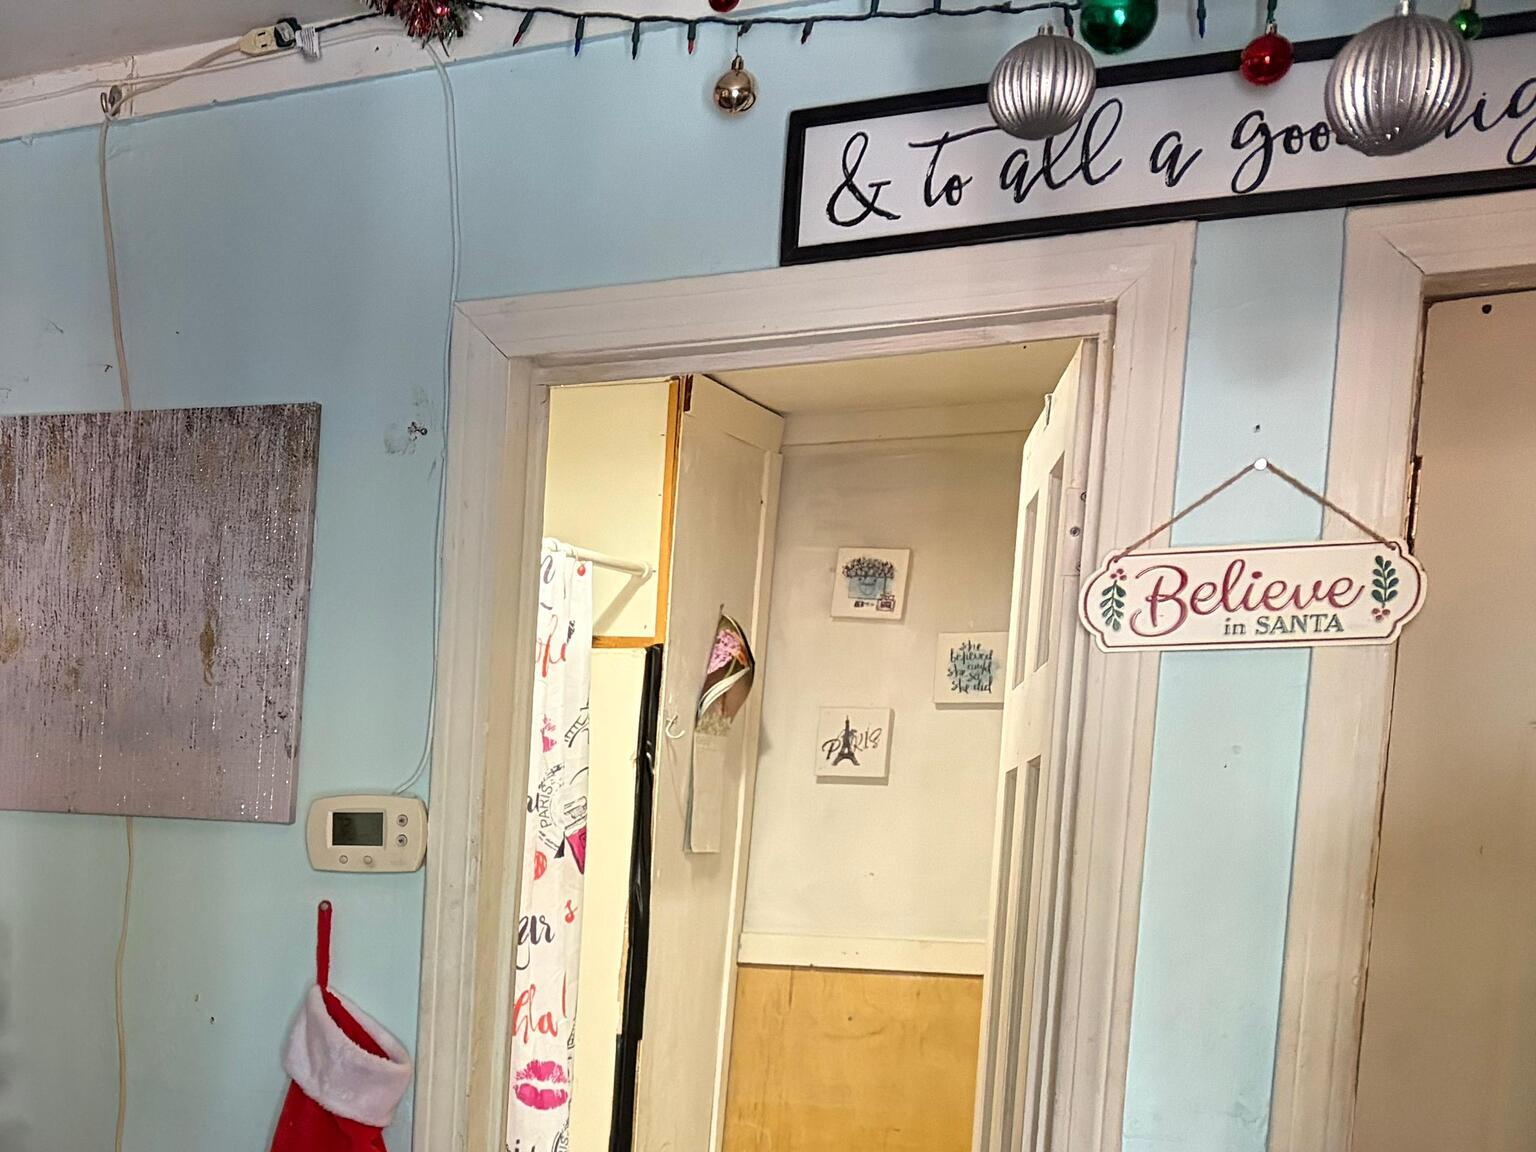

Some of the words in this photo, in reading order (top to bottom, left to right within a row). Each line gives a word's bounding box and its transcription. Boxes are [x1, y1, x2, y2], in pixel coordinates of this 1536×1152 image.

[826, 131, 901, 227] &
[998, 98, 1124, 202] all
[1149, 130, 1202, 187] a
[1230, 109, 1349, 195] goo
[1130, 558, 1366, 638] Believe
[1224, 617, 1246, 636] in
[1254, 613, 1345, 635] SANTA
[539, 784, 553, 828] PARIS
